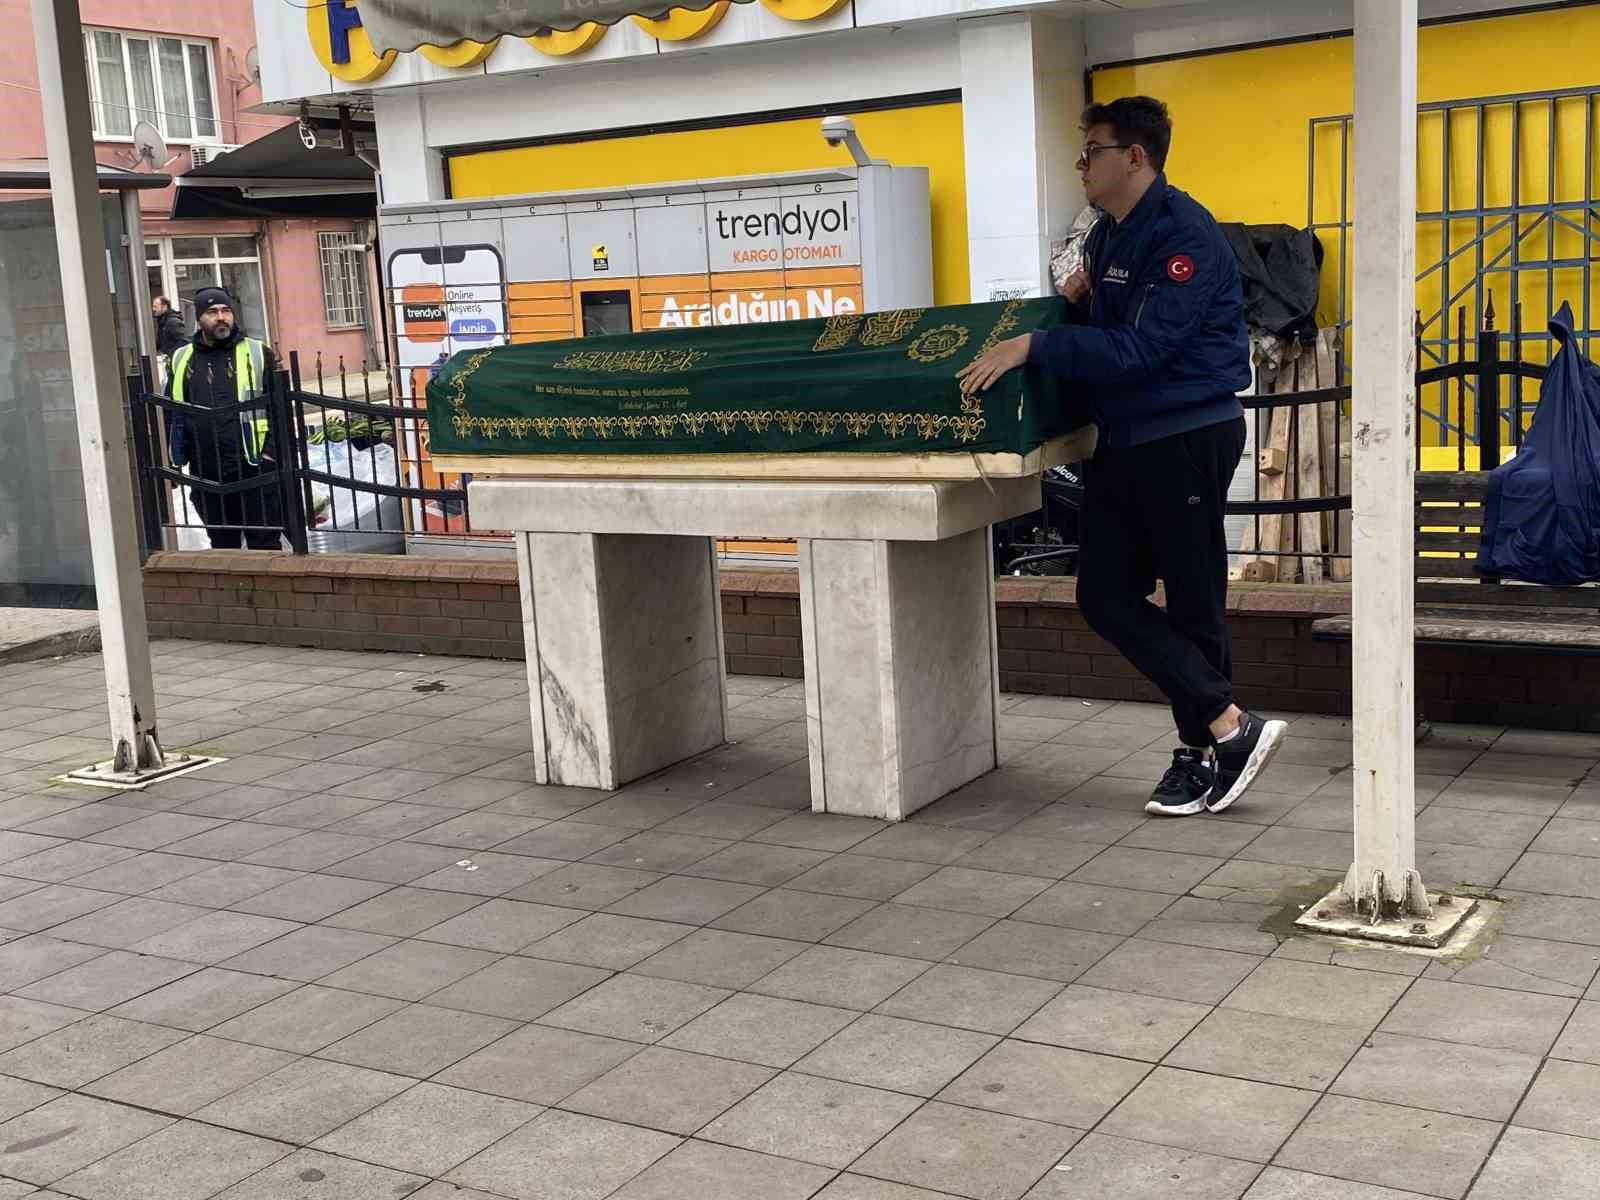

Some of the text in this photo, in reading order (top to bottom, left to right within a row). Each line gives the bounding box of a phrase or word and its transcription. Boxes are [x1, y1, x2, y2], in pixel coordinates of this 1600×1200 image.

[814, 184, 823, 193] G
[715, 200, 848, 240] trendyol
[733, 244, 842, 263] KARGO OTOMATI
[447, 289, 475, 301] Online
[658, 287, 856, 328] Aradığın Ne
